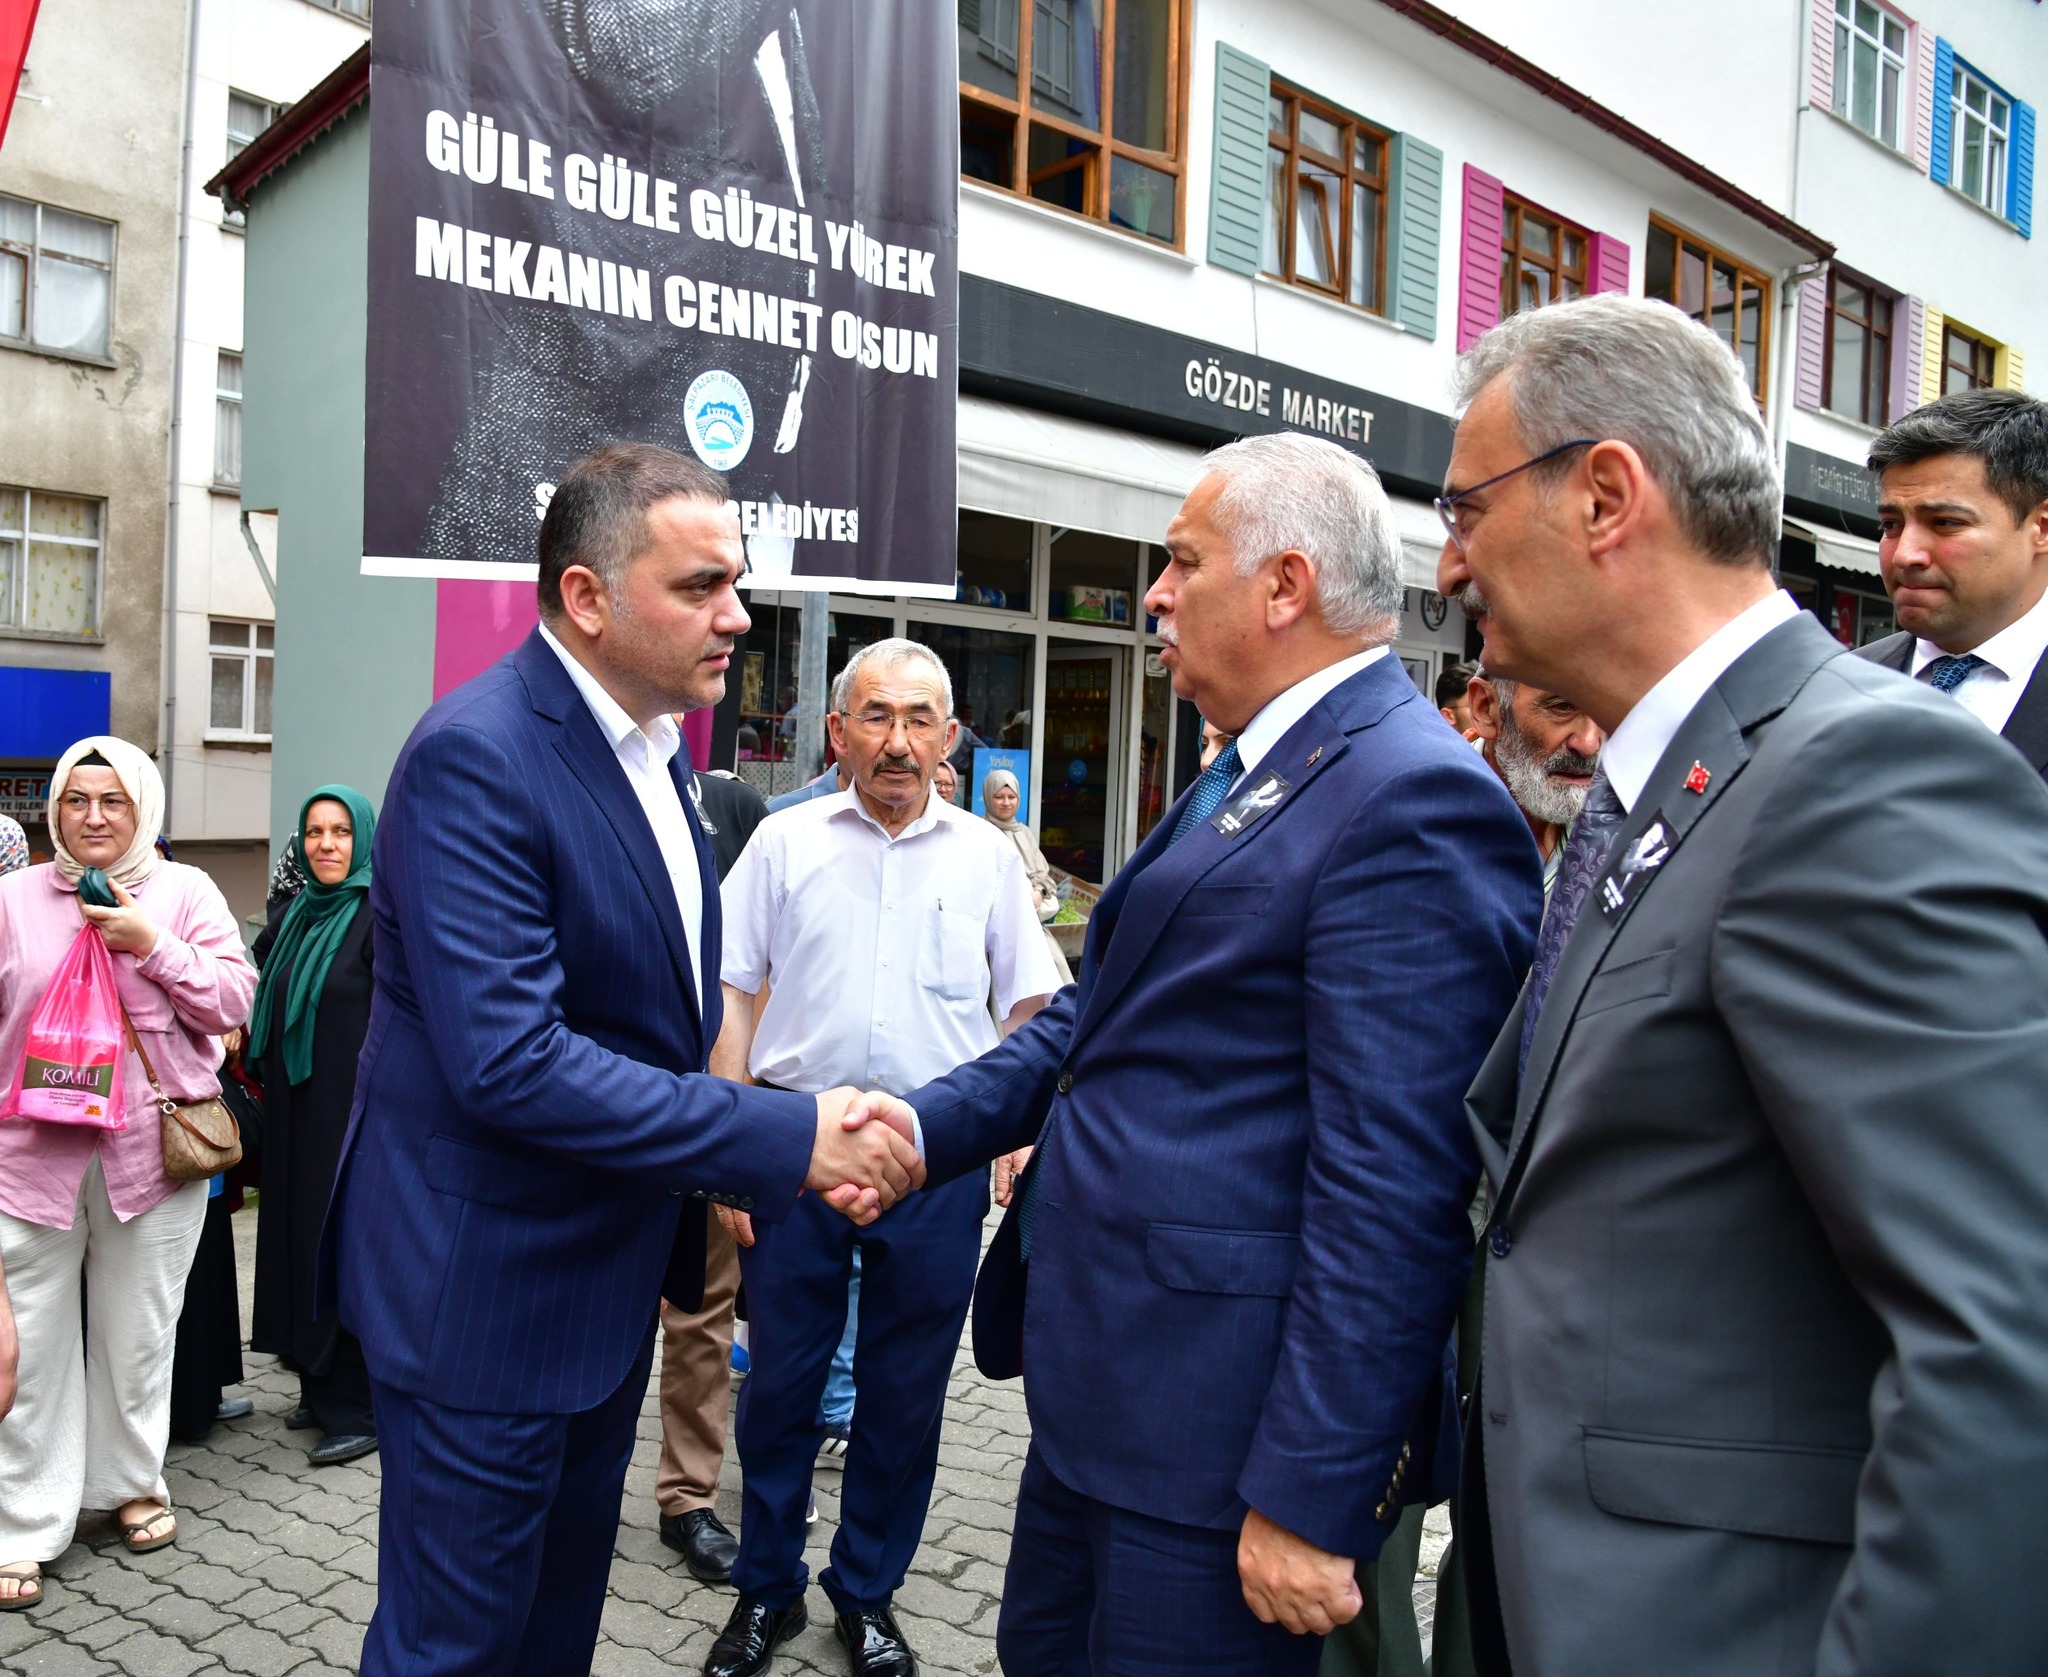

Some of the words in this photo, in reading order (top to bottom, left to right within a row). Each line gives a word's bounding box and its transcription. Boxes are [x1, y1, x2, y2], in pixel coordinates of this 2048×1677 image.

[425, 109, 555, 200] GÜLE
[564, 153, 681, 235] GÜLE
[690, 187, 818, 264] GÜZEL
[826, 220, 936, 297] YÜREK
[415, 216, 652, 323] MEKANIN
[664, 275, 823, 352] CENNET
[831, 310, 938, 379] OLSUN
[1185, 358, 1271, 417] GÖZDE
[1282, 388, 1374, 444] MARKET
[42, 1067, 100, 1087] KOMİLİ
